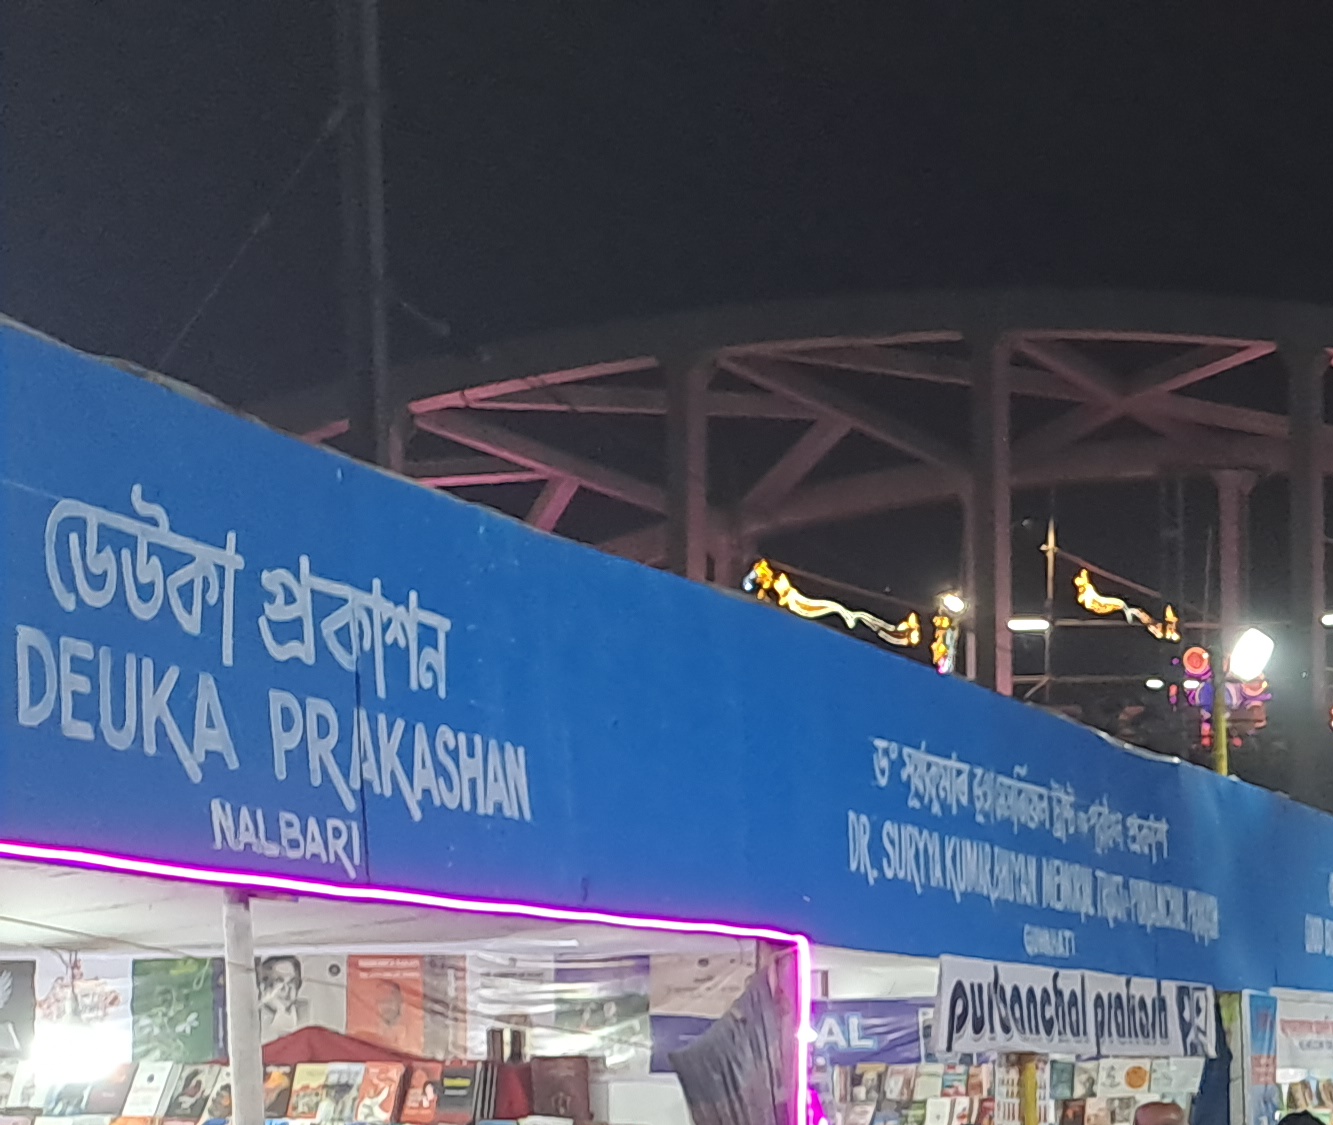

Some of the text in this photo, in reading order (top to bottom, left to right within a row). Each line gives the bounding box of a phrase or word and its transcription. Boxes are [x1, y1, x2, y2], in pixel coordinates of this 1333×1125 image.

[45, 484, 244, 667] ডেউকা
[16, 623, 532, 822] DEUKA PRAKASHAN
[210, 798, 362, 880] NALBARI
[847, 808, 879, 887] DR.
[947, 965, 1088, 1053] purbanchal
